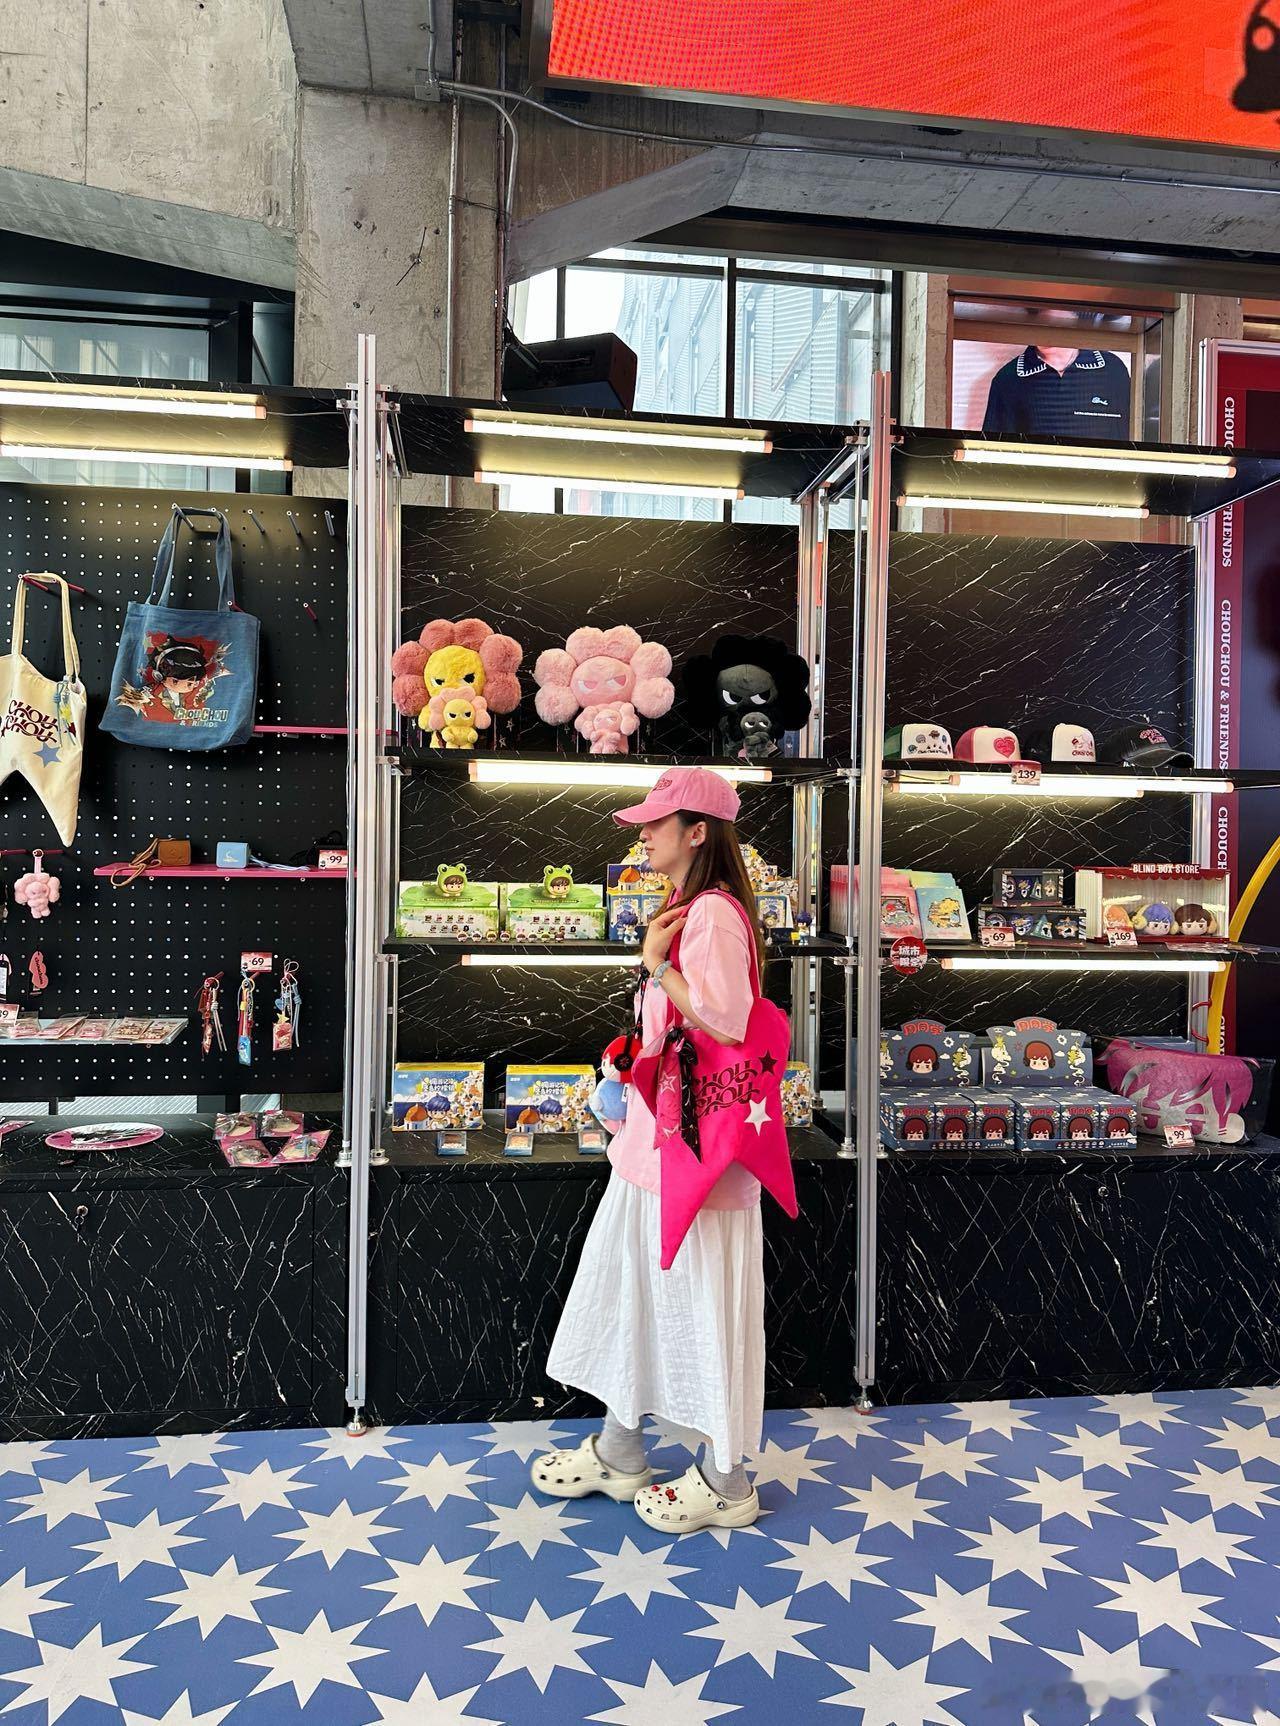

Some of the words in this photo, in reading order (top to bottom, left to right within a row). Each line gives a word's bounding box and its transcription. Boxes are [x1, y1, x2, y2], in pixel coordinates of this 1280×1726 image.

[1220, 599, 1231, 687] CHOUCHOU
[1220, 690, 1230, 700] &
[1219, 703, 1230, 770] FRIENDS
[1018, 769, 1037, 780] 139
[329, 855, 343, 864] 99
[1133, 863, 1156, 874] BLIND
[1157, 863, 1174, 874] BOX
[1175, 864, 1200, 874] STORE
[992, 932, 1006, 942] 69
[251, 957, 265, 966] 69
[1173, 1130, 1185, 1140] 99
